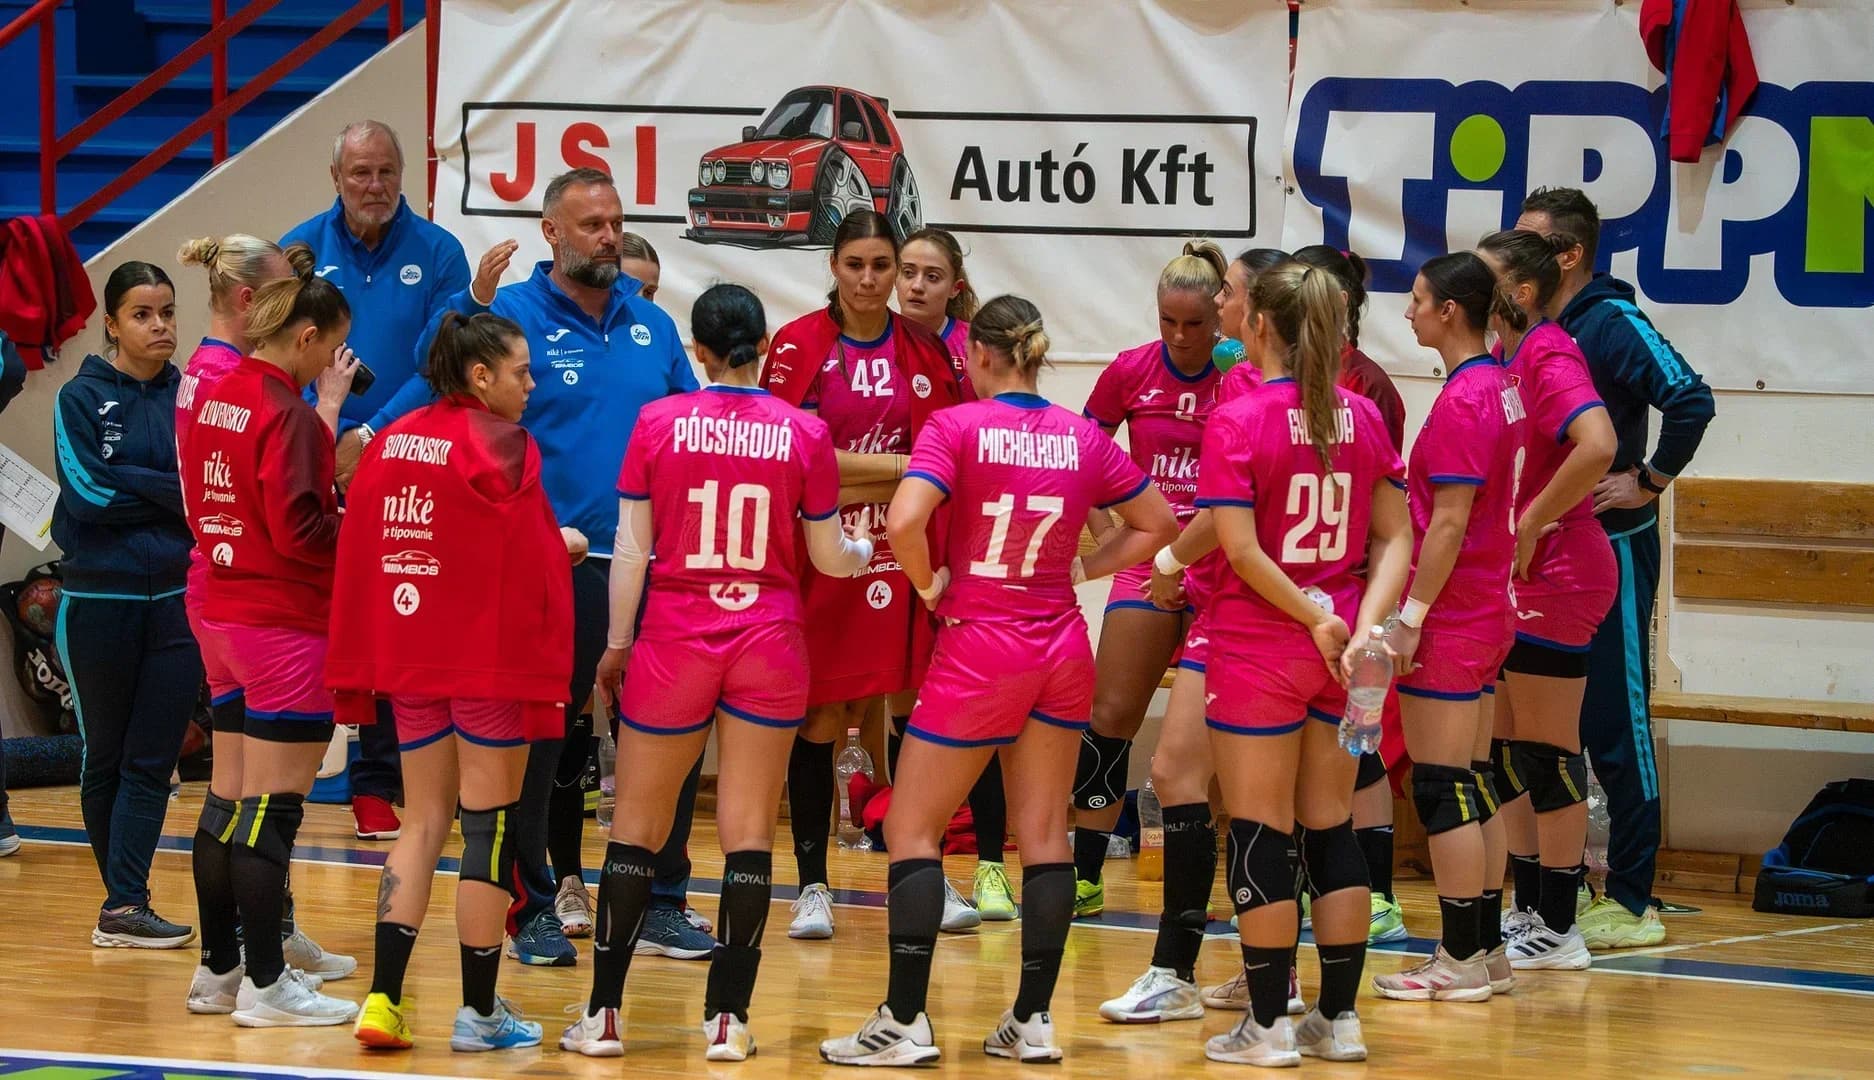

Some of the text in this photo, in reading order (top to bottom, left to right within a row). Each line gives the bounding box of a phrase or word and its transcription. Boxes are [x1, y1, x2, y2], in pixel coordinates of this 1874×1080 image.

[489, 121, 1215, 207] JSI Autó Kft
[851, 358, 894, 398] 42
[673, 406, 793, 462] PÓCSÍKOVÁ
[977, 423, 1080, 472] MICHÁLKOVÁ
[383, 484, 434, 525] niké
[685, 479, 771, 572] 10
[1281, 472, 1352, 564] 29
[390, 526, 433, 541] tipovanie
[969, 493, 1065, 578] 17
[612, 862, 645, 877] ROYAL
[733, 872, 766, 886] ROYAL
